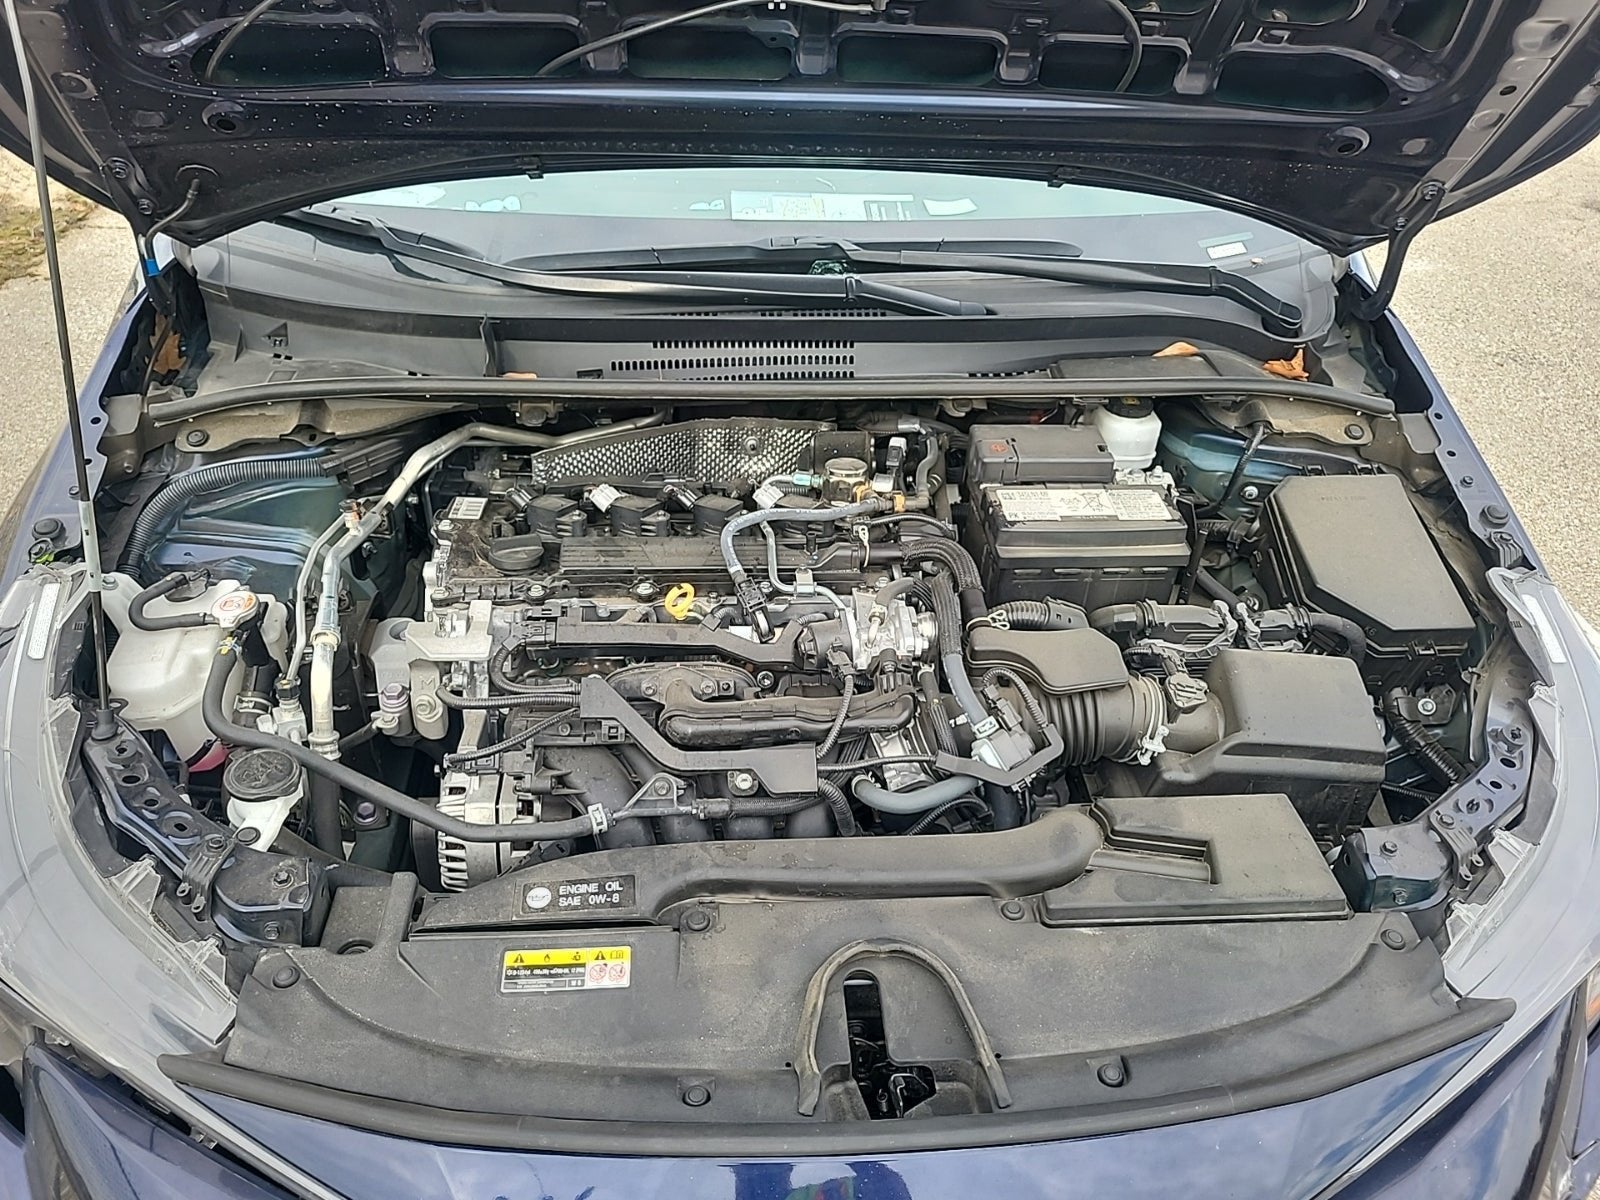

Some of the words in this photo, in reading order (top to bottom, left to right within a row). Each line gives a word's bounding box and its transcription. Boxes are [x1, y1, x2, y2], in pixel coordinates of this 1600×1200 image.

[559, 883, 599, 895] ENGINE
[605, 881, 623, 891] OIL
[559, 896, 581, 906] SAE
[589, 893, 619, 904] 0W-8
